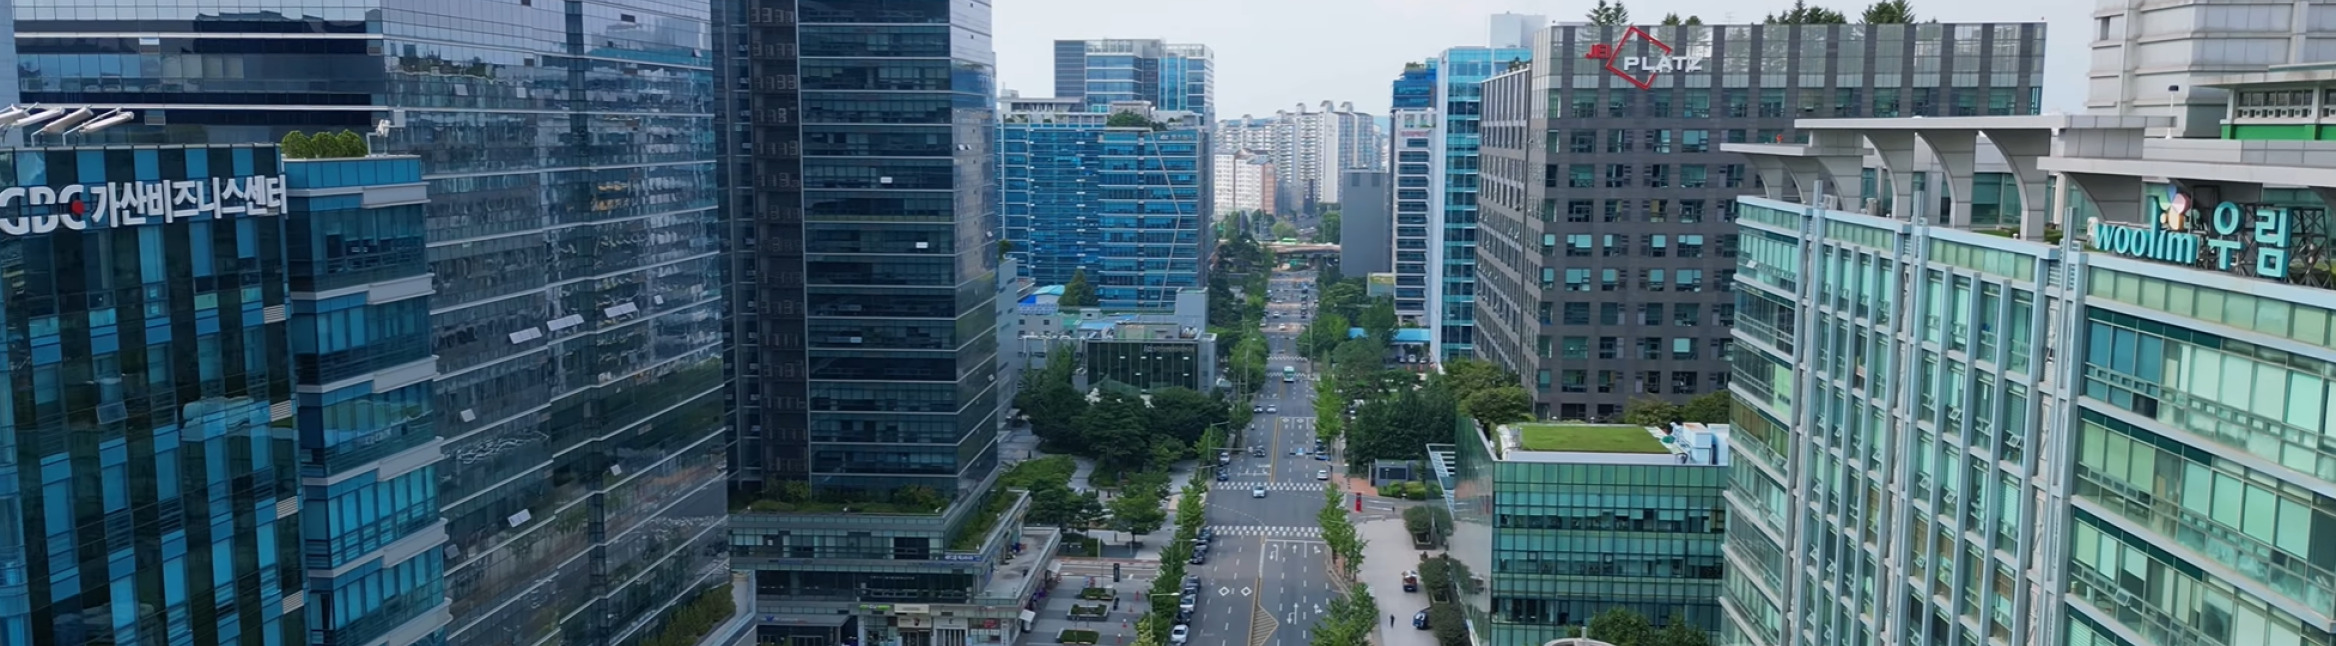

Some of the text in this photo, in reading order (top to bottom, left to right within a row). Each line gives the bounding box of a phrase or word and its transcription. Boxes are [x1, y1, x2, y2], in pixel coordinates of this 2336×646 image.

[1624, 55, 1703, 73] PLATZ
[0, 174, 288, 236] GBC 가산비즈니스센터
[2094, 196, 2294, 279] woolim 우림
